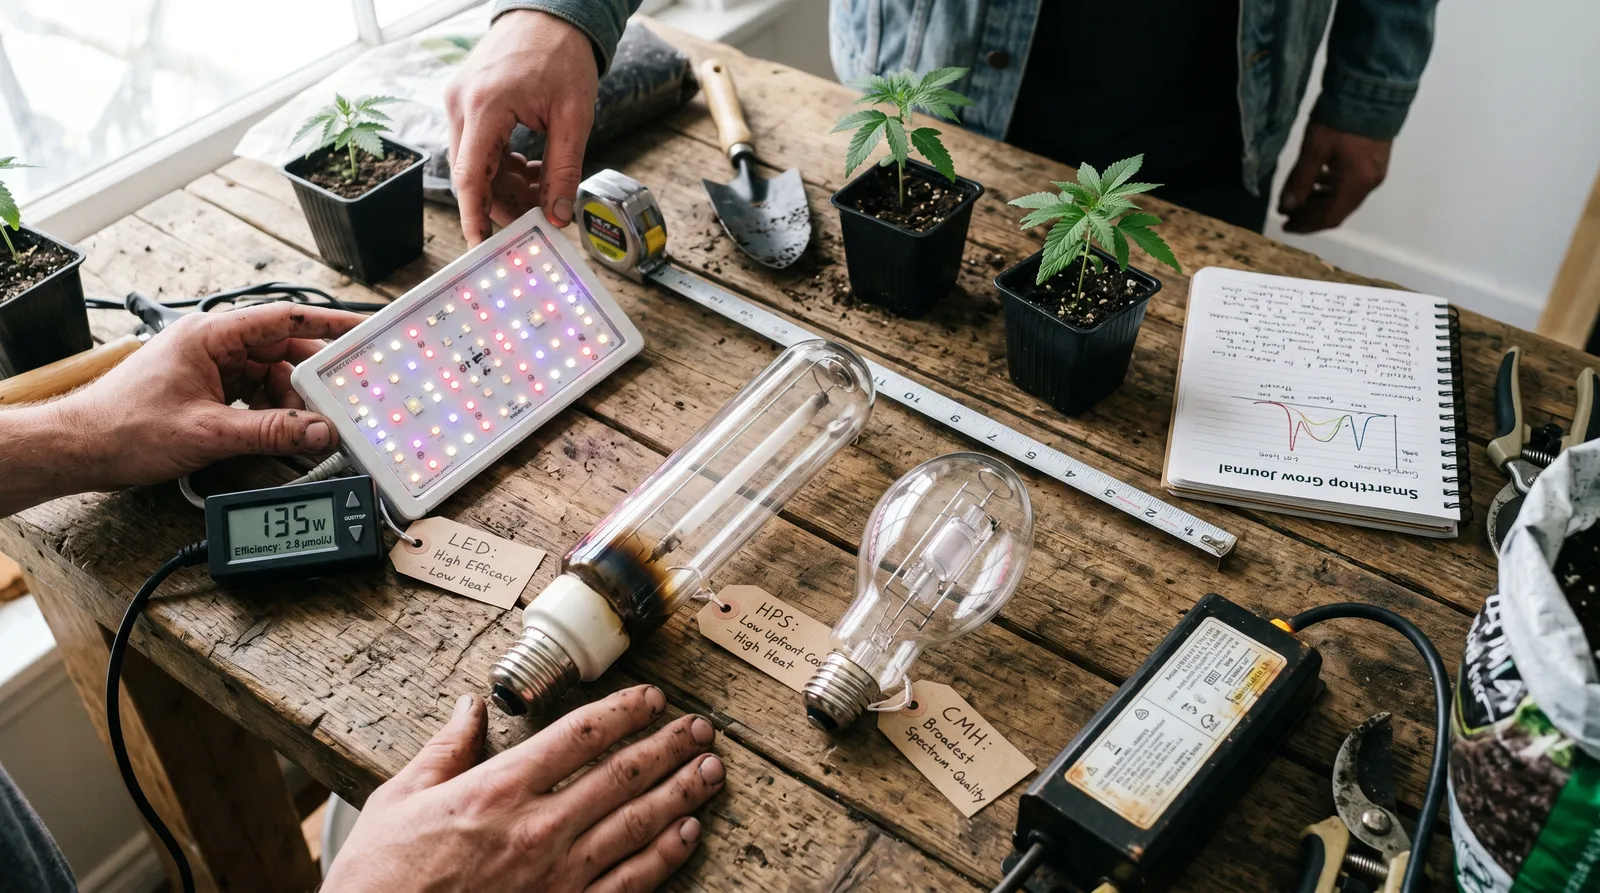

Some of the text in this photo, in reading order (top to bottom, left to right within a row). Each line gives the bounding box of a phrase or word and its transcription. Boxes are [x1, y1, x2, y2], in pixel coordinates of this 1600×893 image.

[903, 392, 922, 404] 10
[950, 414, 961, 423] 9
[986, 434, 998, 442] 7
[1025, 451, 1037, 460] 5
[1064, 470, 1077, 478] 4
[1219, 463, 1278, 481] Journal
[1281, 472, 1324, 487] Grow
[1104, 489, 1116, 498] 3
[1145, 508, 1158, 518] 2
[234, 543, 282, 557] Efficiency:
[285, 539, 300, 550] 2.8
[448, 532, 498, 559] LED:
[433, 549, 517, 586] High Efficacy
[459, 575, 492, 593] Heat
[755, 602, 799, 632] HPS:
[739, 615, 823, 668] Low Upfront Cos
[763, 648, 795, 670] Heat
[942, 706, 992, 750] CMH:
[922, 717, 974, 765] Broadest
